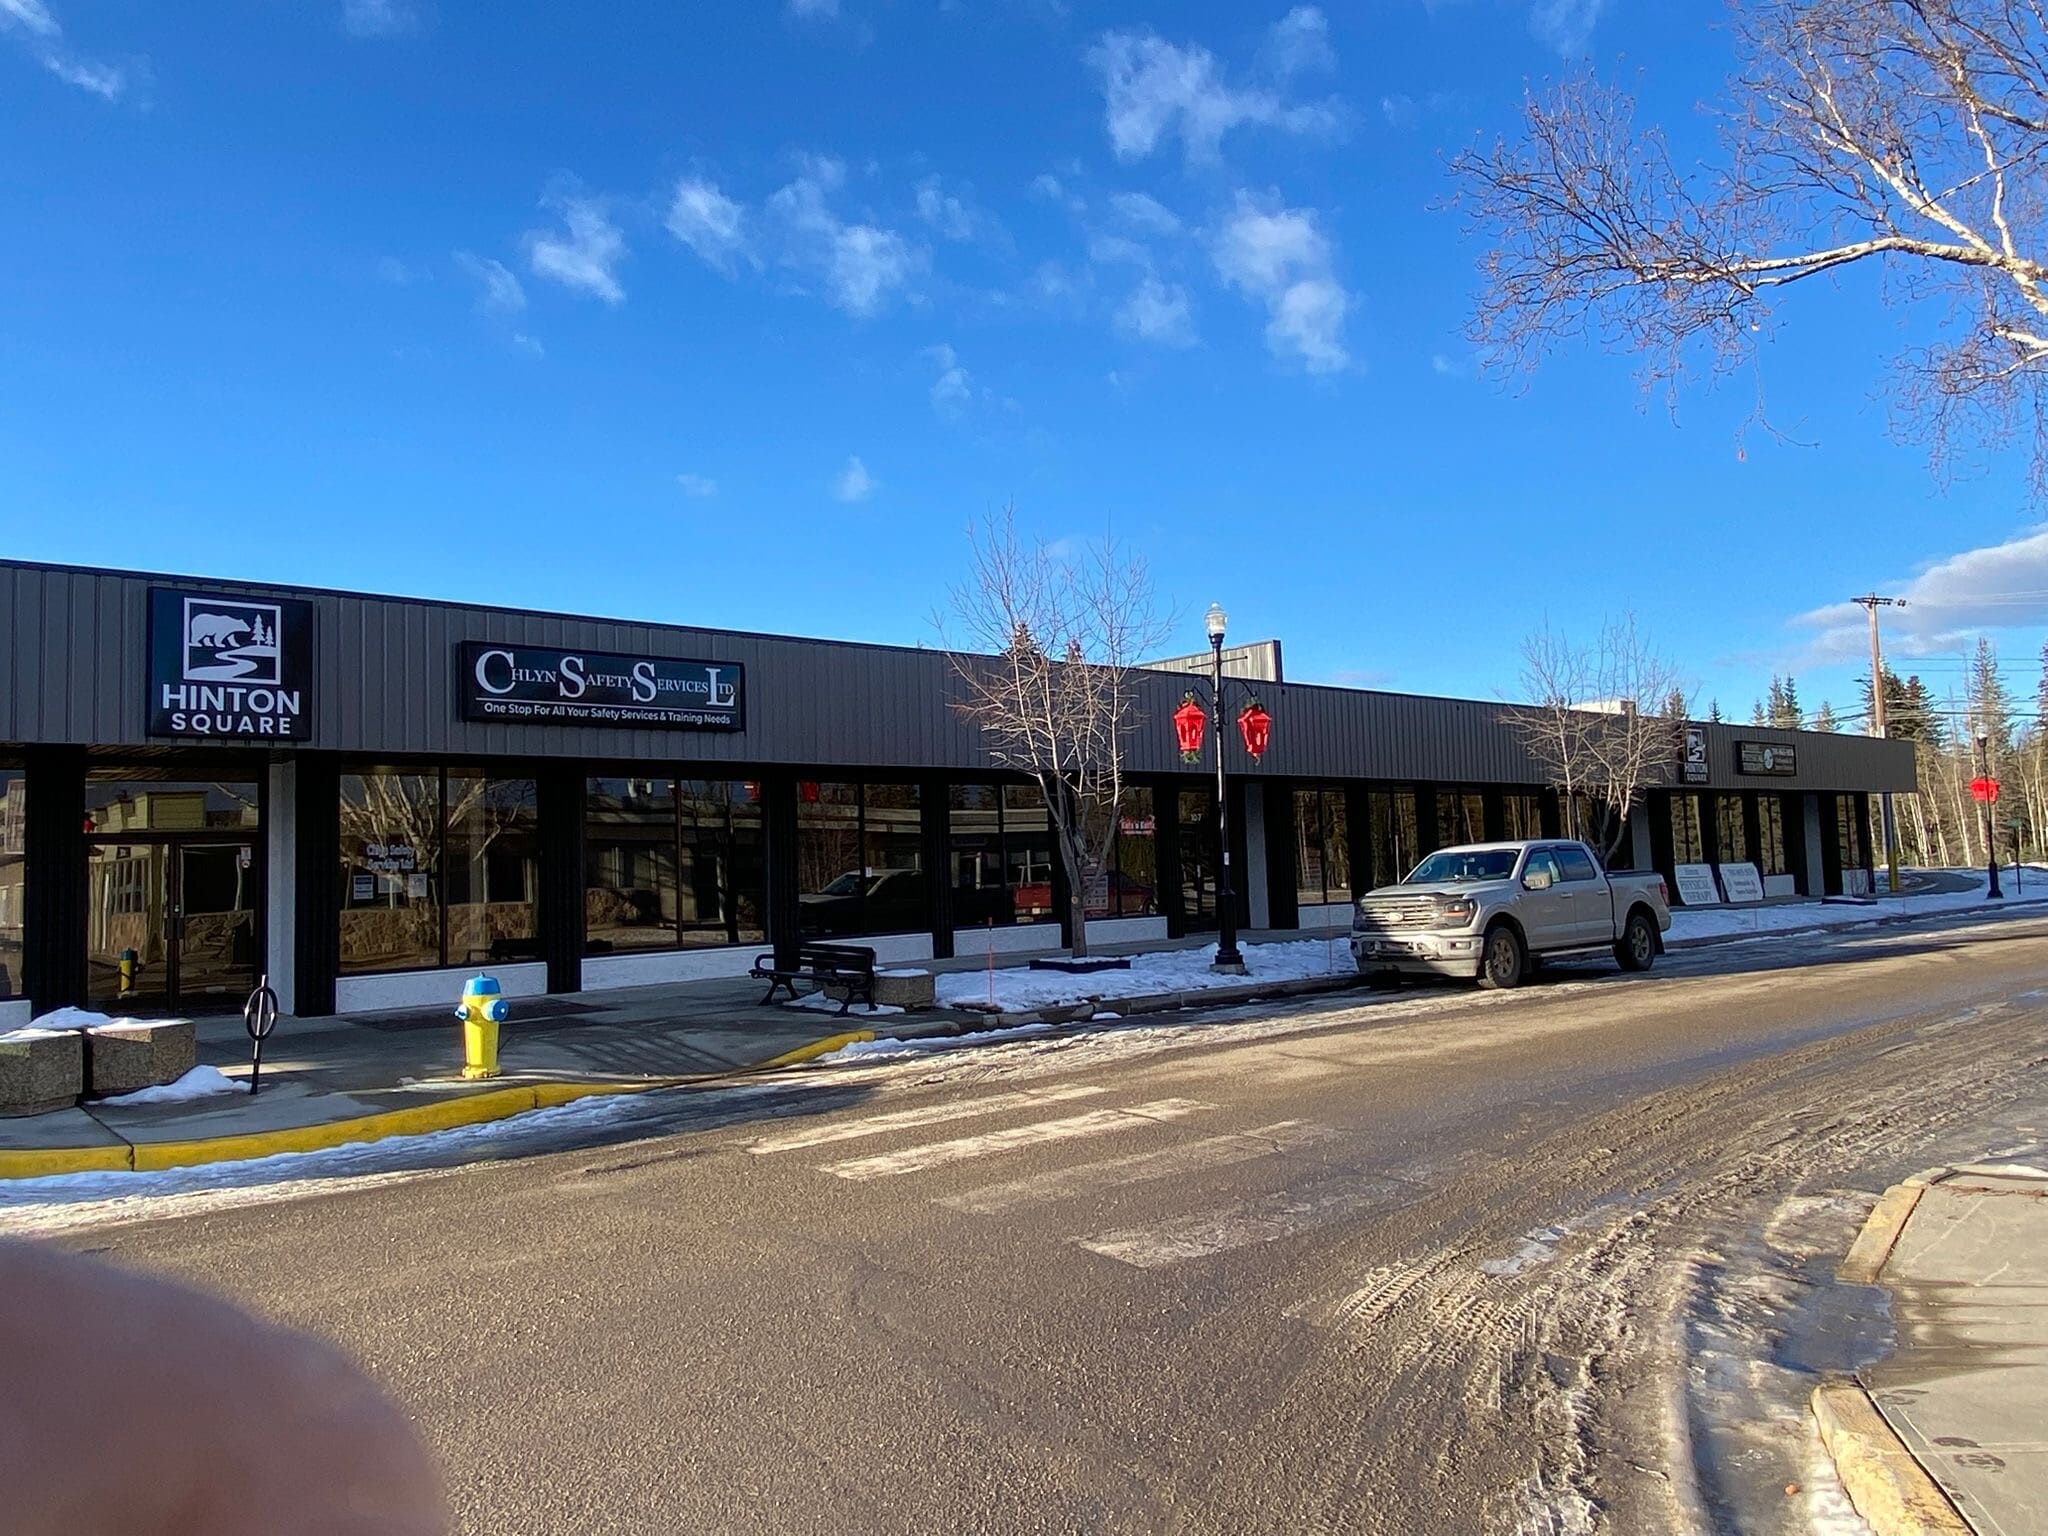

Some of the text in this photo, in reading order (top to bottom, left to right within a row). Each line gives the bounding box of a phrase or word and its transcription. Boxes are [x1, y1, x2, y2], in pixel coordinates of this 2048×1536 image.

[475, 650, 557, 694] CHLYN
[559, 656, 634, 698] SAFETY
[632, 662, 709, 702] SERVICES
[162, 684, 300, 715] HINTON
[171, 712, 291, 735] SQUARE
[484, 702, 731, 725] One Stop For All Your Safety Services & Training Needs
